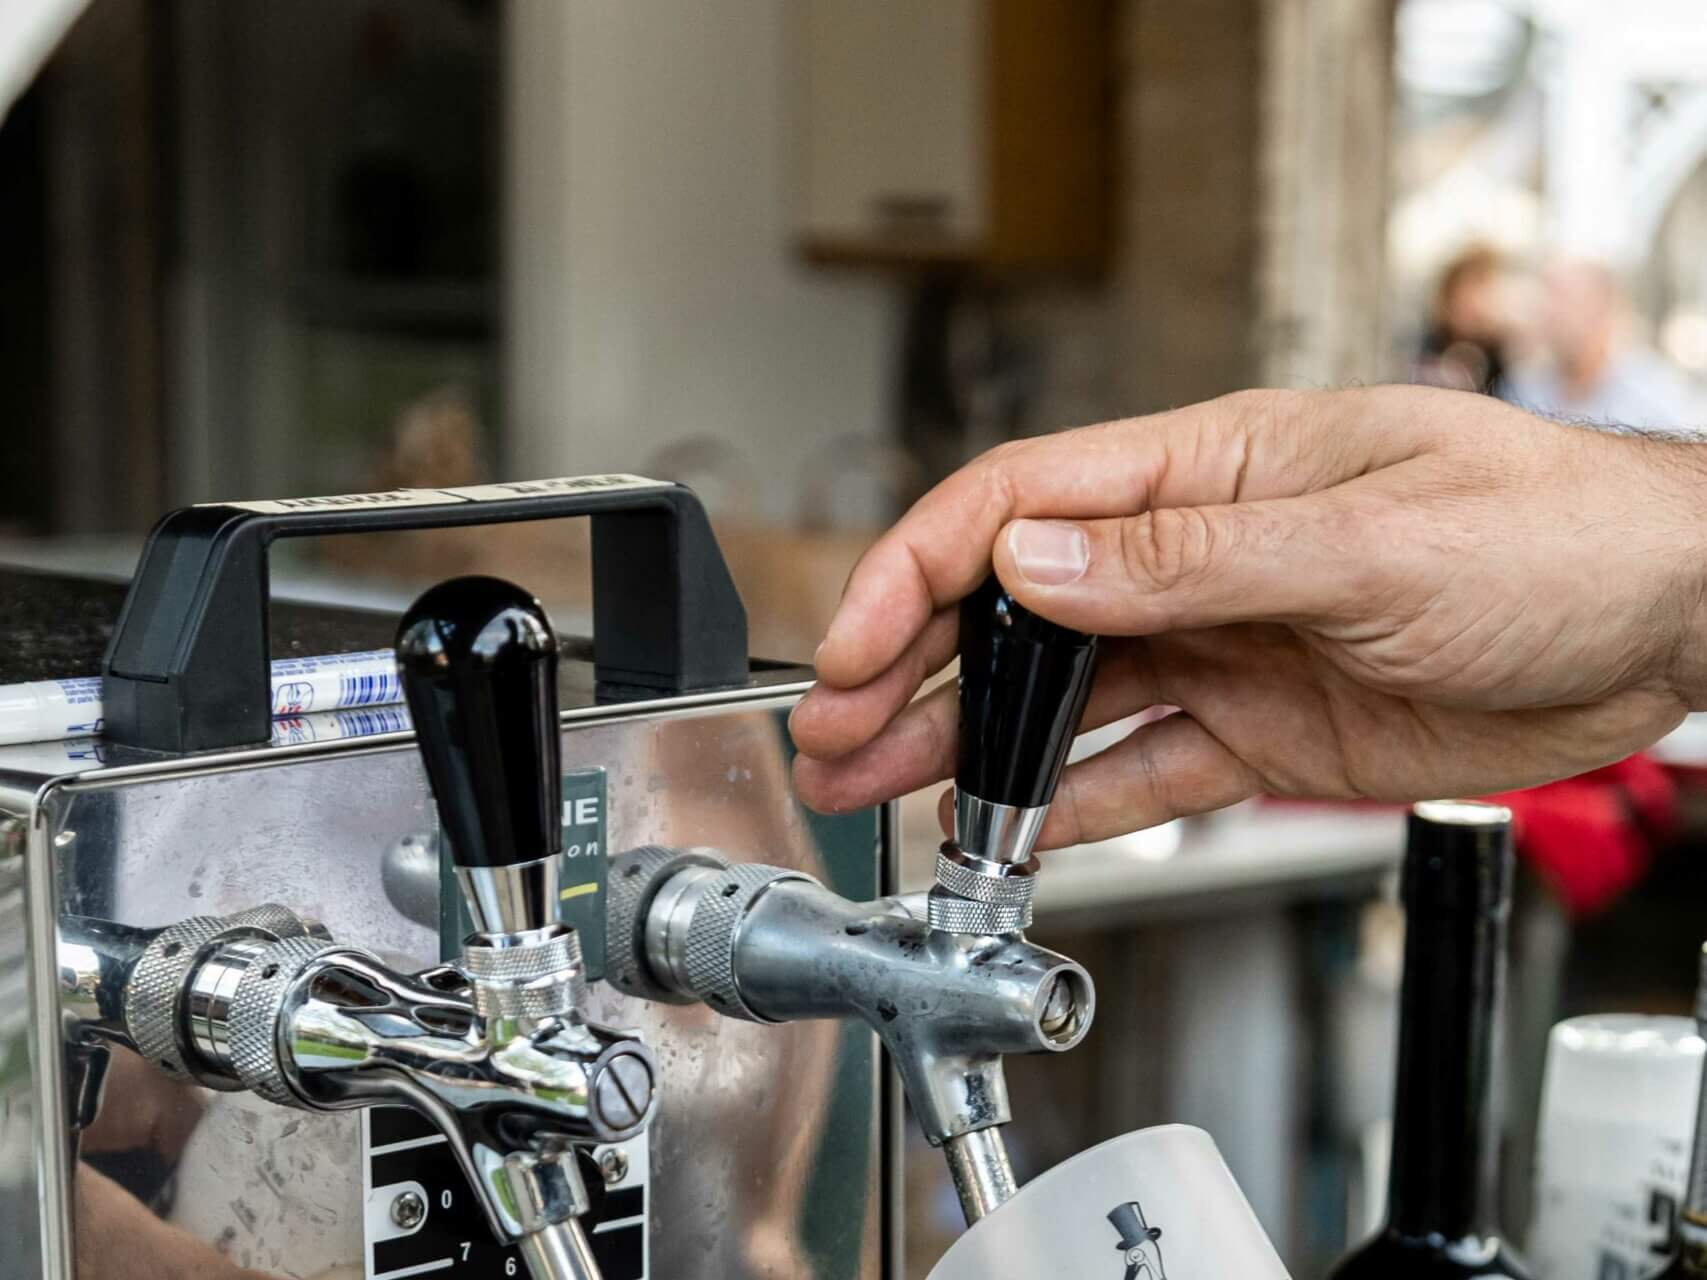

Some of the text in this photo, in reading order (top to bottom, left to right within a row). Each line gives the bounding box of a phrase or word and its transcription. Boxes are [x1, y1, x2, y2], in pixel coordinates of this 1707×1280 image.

[440, 1189, 453, 1209] 0
[460, 1242, 471, 1261] 7
[505, 1257, 516, 1276] 6
